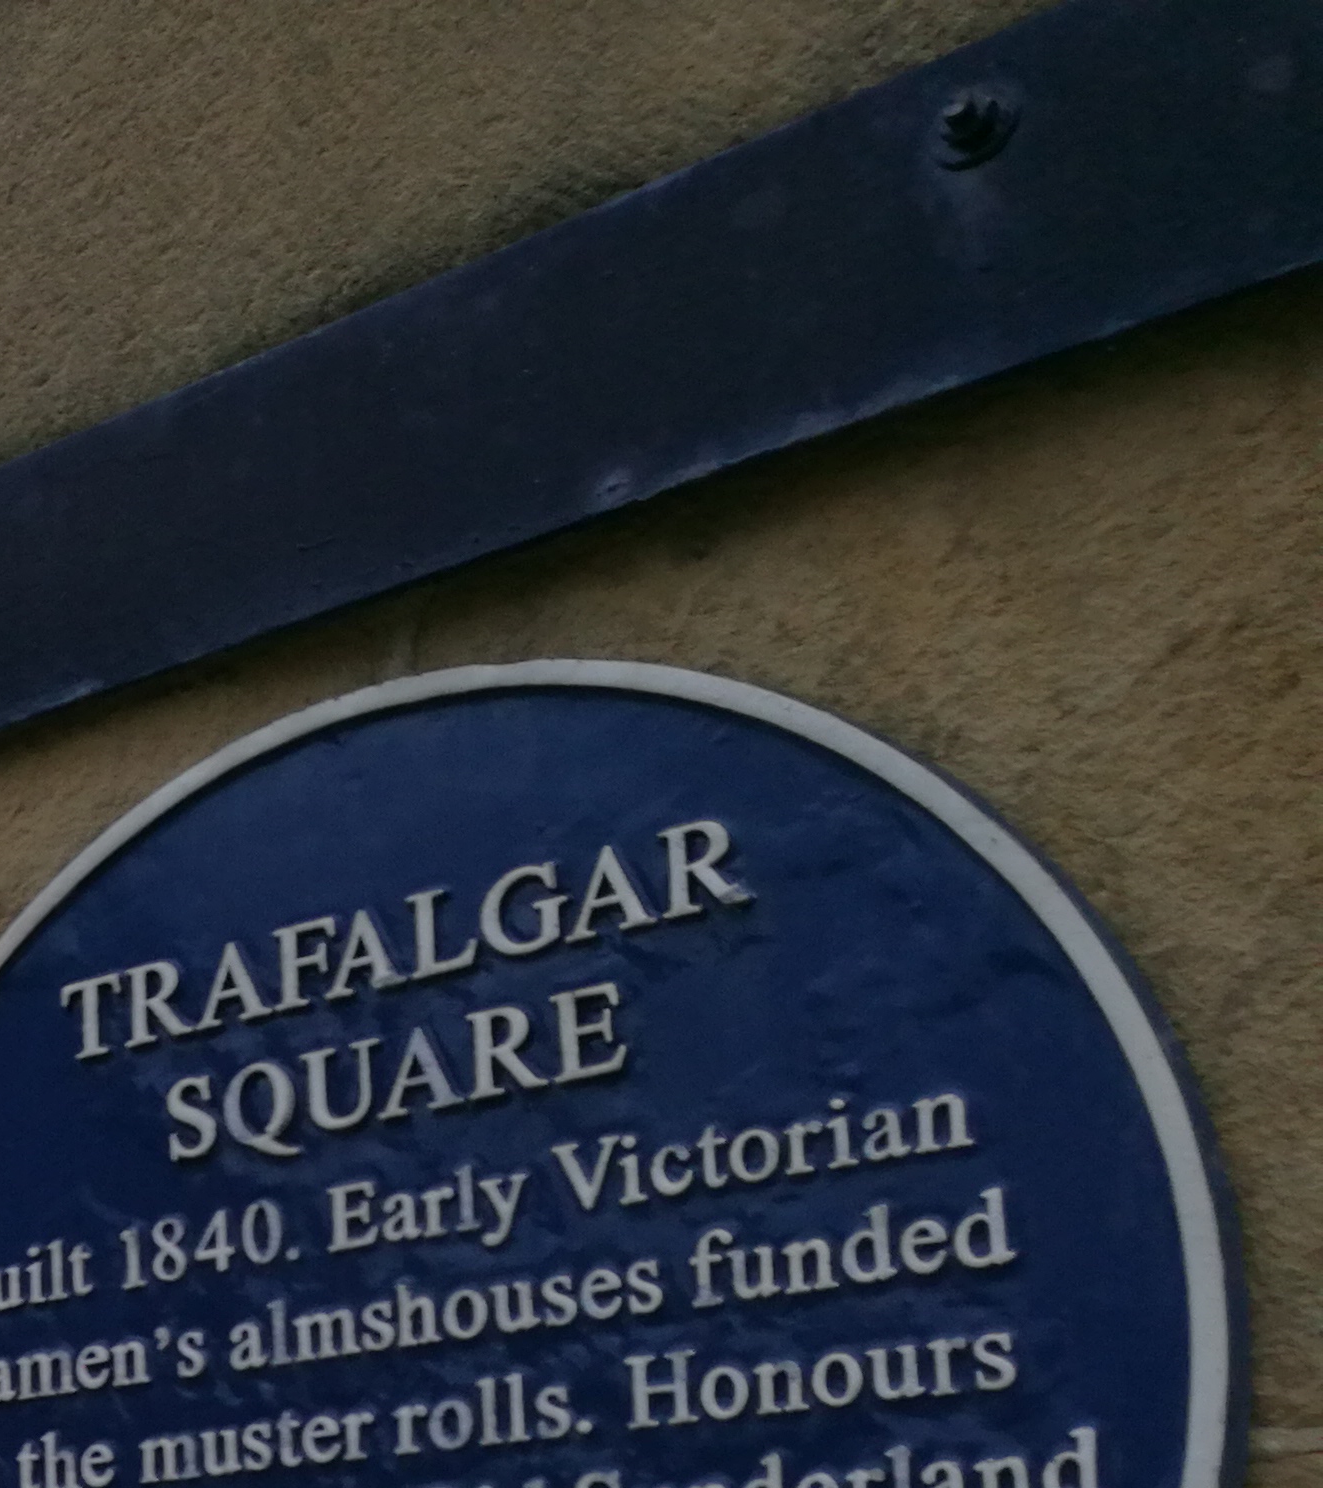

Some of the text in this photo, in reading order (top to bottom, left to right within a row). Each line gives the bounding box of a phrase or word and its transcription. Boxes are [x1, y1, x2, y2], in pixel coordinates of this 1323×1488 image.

[59, 819, 750, 1060] TRAFALGAR
[166, 981, 637, 1161] SQUARE
[119, 1199, 300, 1290] 1840.
[326, 1164, 528, 1253] Early
[550, 1092, 975, 1211] Victorian
[229, 1258, 664, 1371] almshouses
[688, 1185, 1017, 1308] funded
[138, 1410, 376, 1484] muster
[392, 1371, 594, 1456] rolls.
[622, 1331, 1017, 1430] Honours
